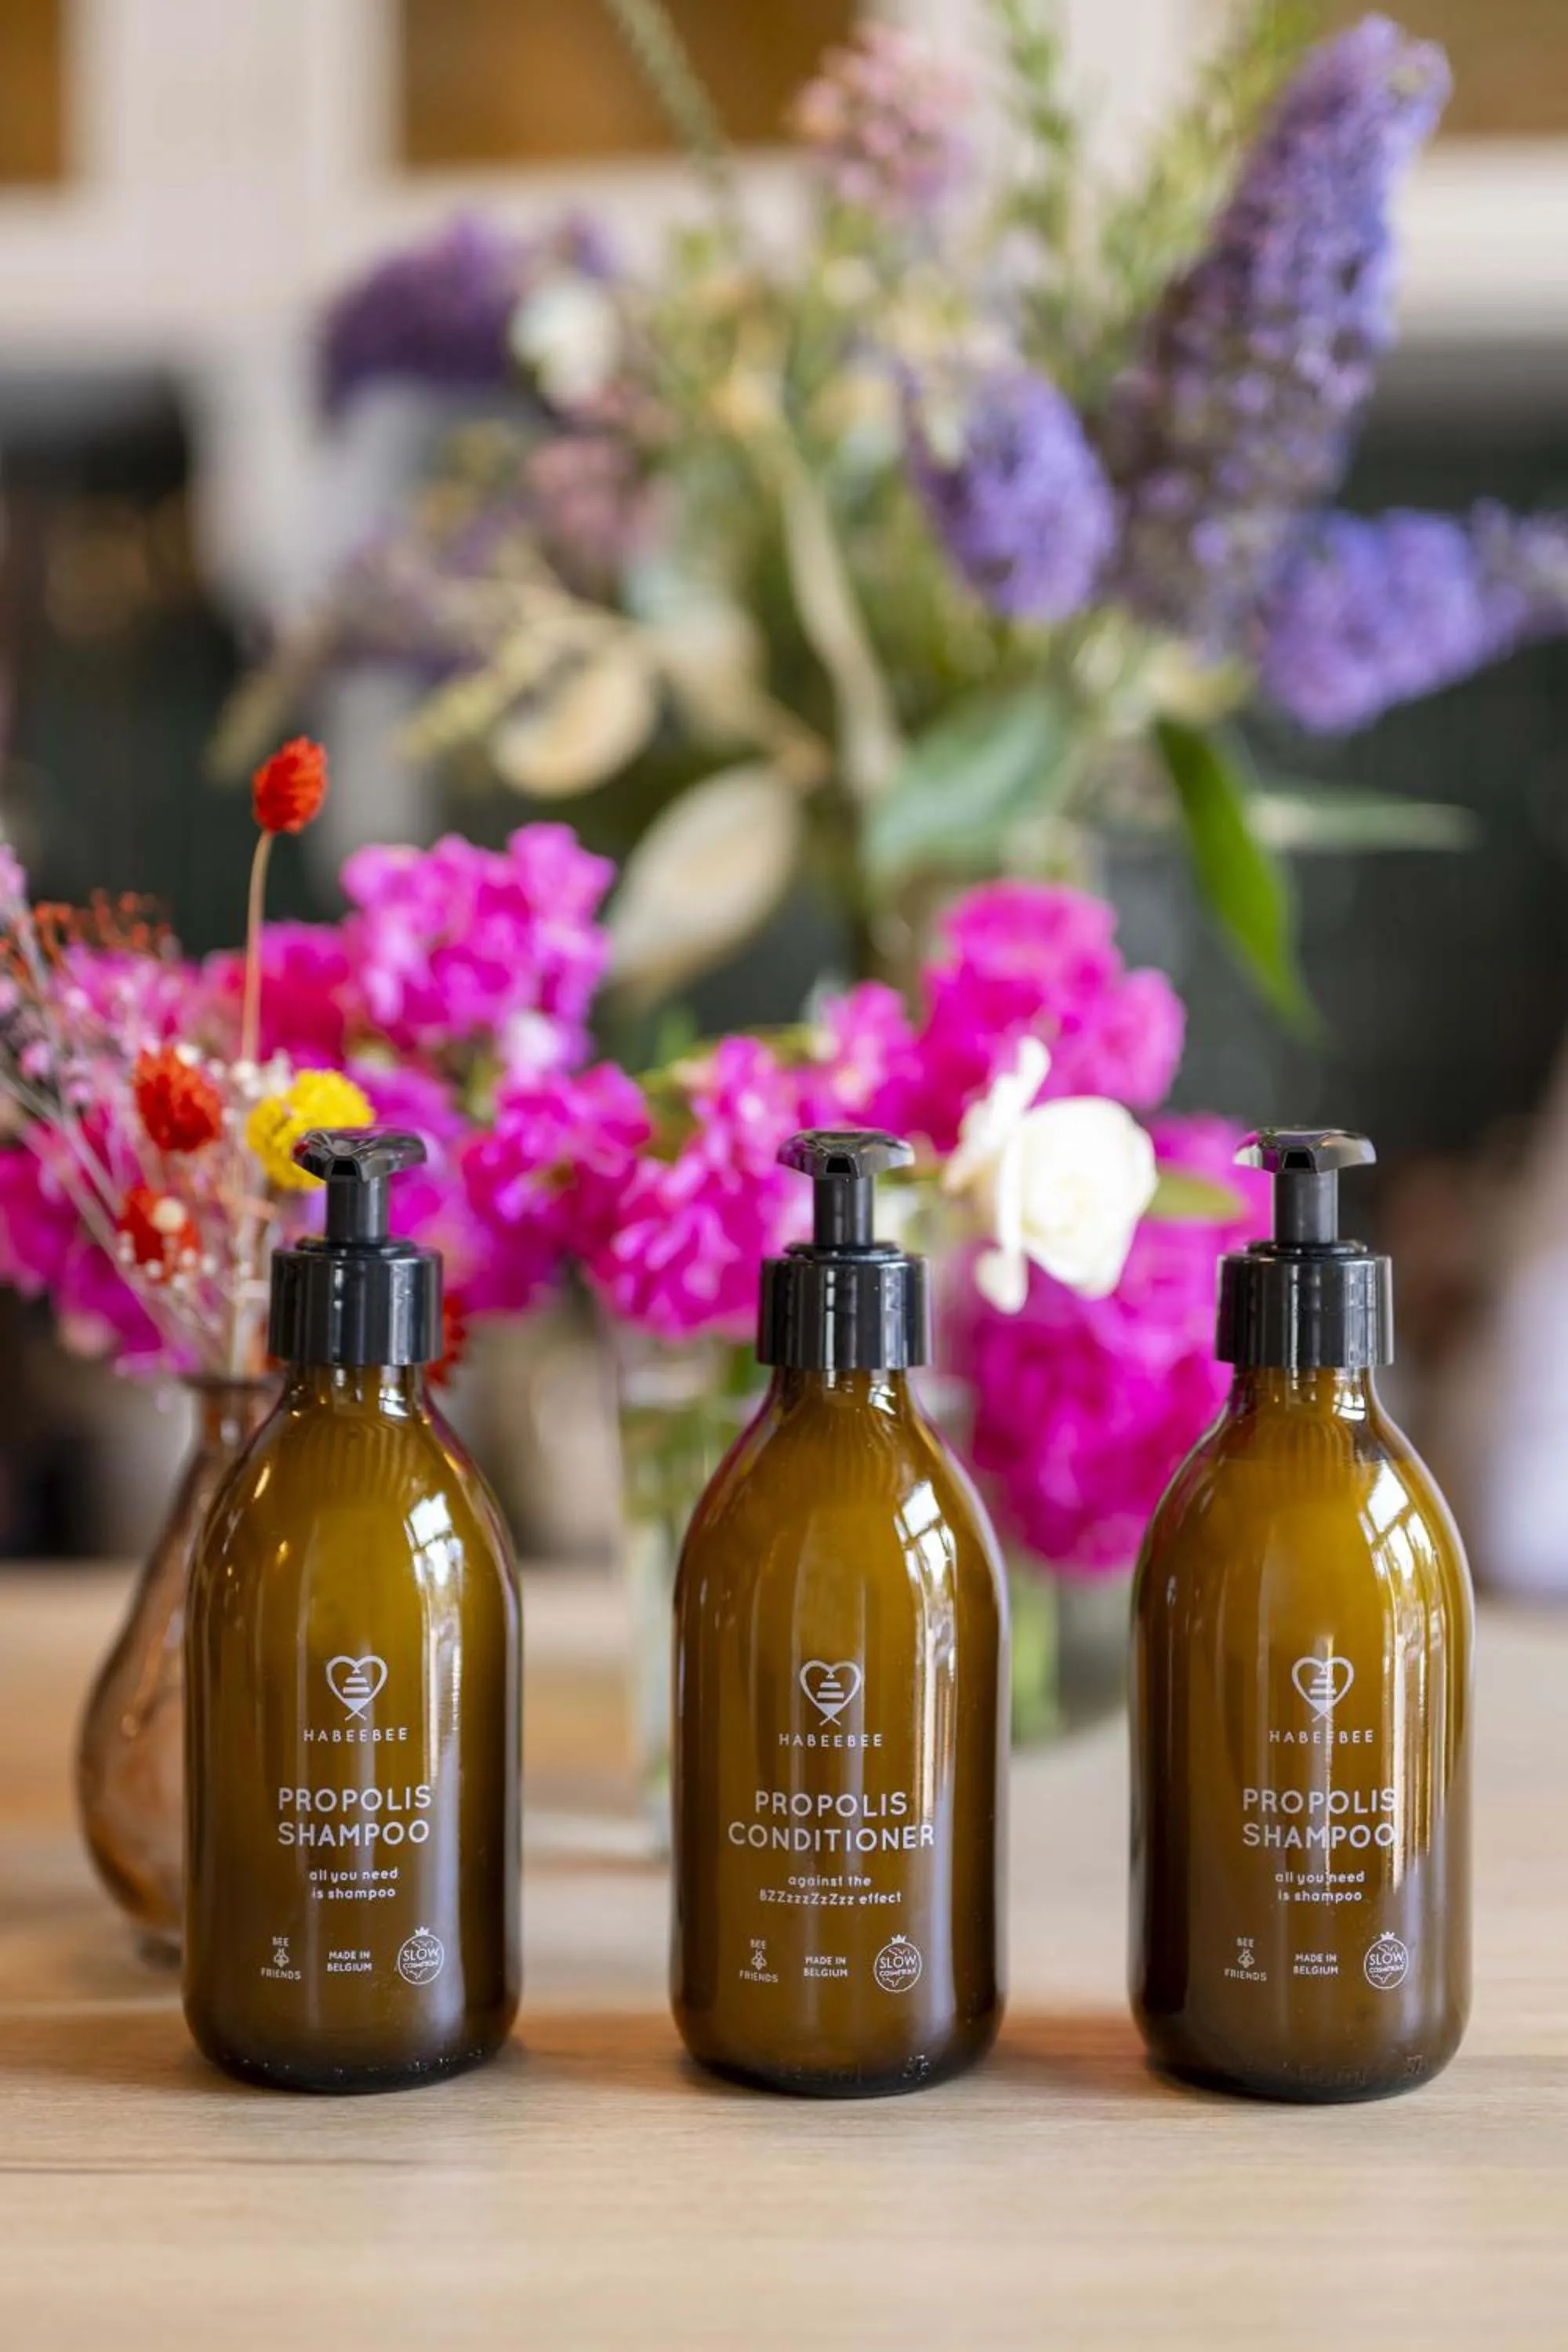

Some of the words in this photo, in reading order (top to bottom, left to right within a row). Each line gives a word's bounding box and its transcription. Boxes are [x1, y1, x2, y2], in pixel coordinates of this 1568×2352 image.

[303, 1727, 408, 1742] HABEEBEE
[779, 1733, 883, 1748] HABEEBEE
[1269, 1730, 1374, 1744] HABEEBEE
[278, 1785, 431, 1813] PROPOLIS
[755, 1791, 907, 1817] PROPOLIS
[1243, 1788, 1396, 1814] PROPOLIS
[278, 1819, 430, 1846] SHAMPOO
[728, 1821, 934, 1852] CONDITIONER
[1243, 1822, 1396, 1849] SHAMPOO
[309, 1869, 327, 1881] all
[331, 1871, 357, 1883] you
[361, 1867, 398, 1880] need
[787, 1875, 843, 1888] against
[848, 1875, 872, 1887] the
[1275, 1871, 1294, 1882] all
[1298, 1872, 1324, 1885] you
[1327, 1870, 1365, 1883] need
[311, 1887, 324, 1899] is
[328, 1887, 396, 1900] shampoo
[859, 1891, 902, 1904] effect
[1278, 1890, 1290, 1901] is
[1294, 1889, 1363, 1904] shampoo
[272, 1936, 289, 1947] BEE
[1236, 1936, 1254, 1948] BEE
[328, 1950, 356, 1960] MADE
[359, 1950, 371, 1959] IN
[403, 1947, 440, 1962] SLOW
[804, 1955, 832, 1965] MADE
[835, 1955, 846, 1965] IN
[1294, 1953, 1323, 1962] MADE
[1326, 1953, 1338, 1962] IN
[1370, 1951, 1404, 1965] SLOW
[326, 1962, 373, 1973] BELGIUM
[879, 1955, 916, 1969] SLOW
[260, 1967, 302, 1981] FRIENDS
[739, 1969, 779, 1983] FRIENDS
[803, 1967, 848, 1977] BELGIUM
[1224, 1967, 1268, 1982] FRIENDS
[1293, 1965, 1339, 1976] BELGIUM
